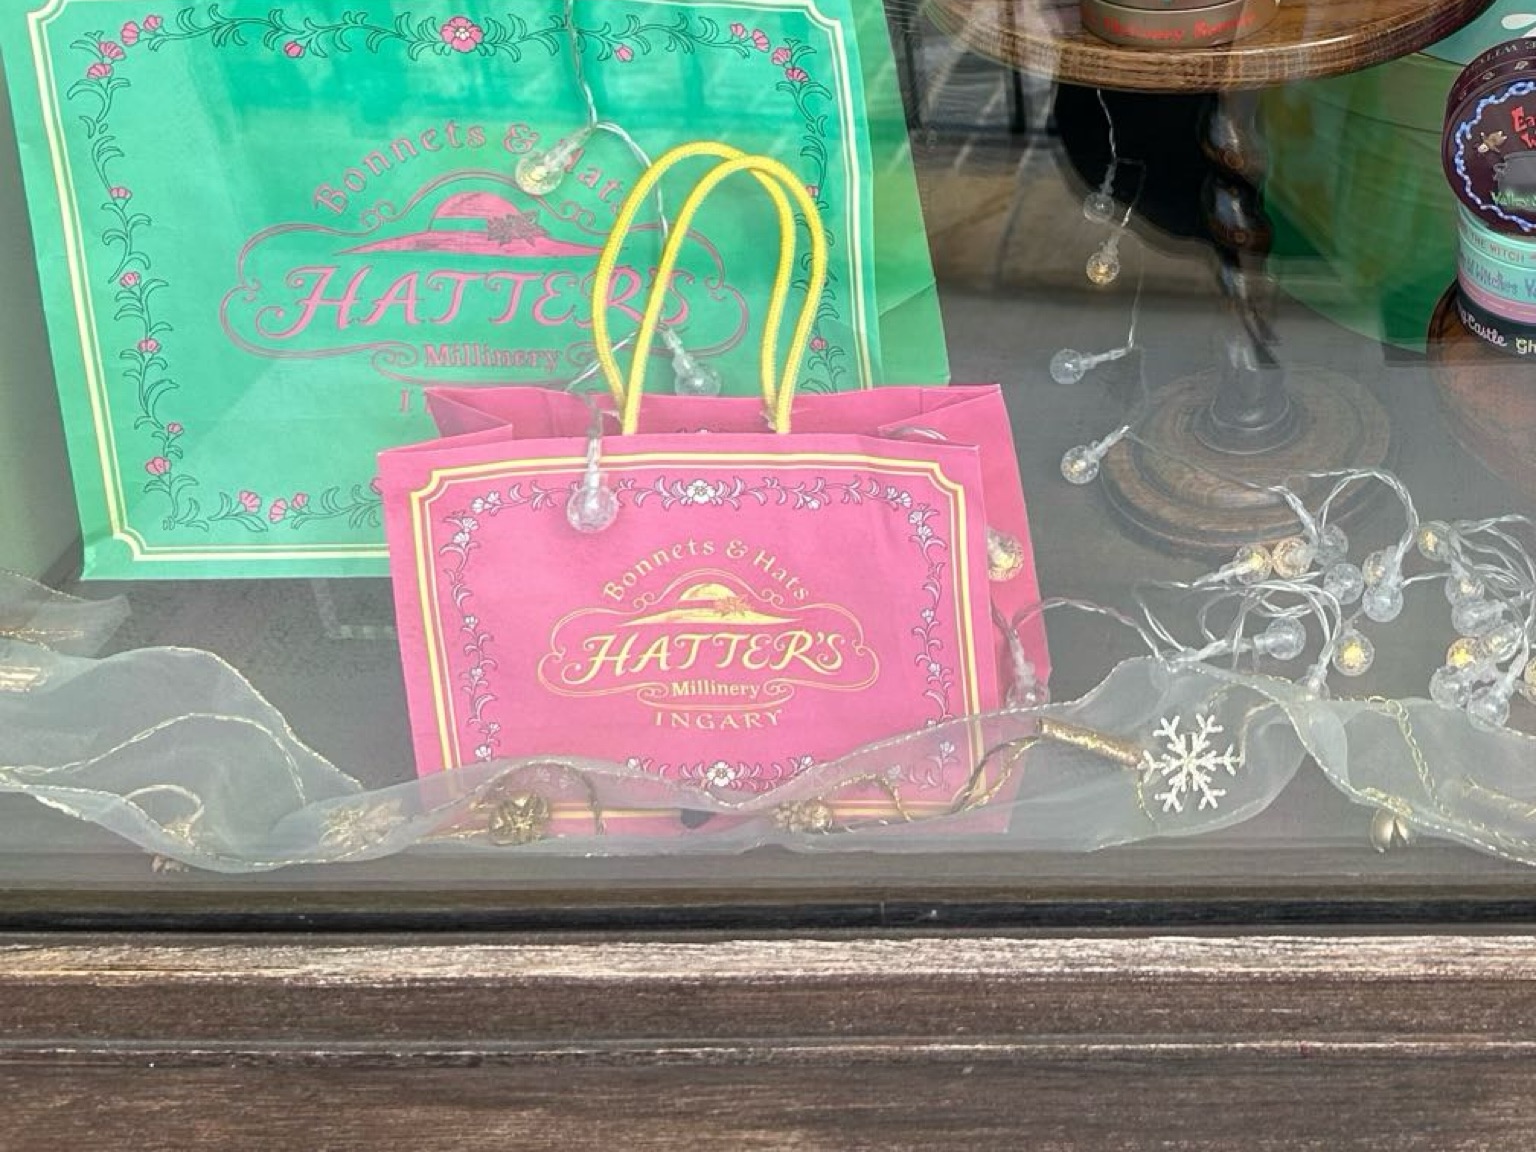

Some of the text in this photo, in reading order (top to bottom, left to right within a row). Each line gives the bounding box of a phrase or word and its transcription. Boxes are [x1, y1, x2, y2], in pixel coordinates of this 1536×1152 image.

[312, 118, 487, 216] Bonnets
[502, 123, 541, 154] &
[1467, 312, 1508, 347] Castle
[424, 345, 560, 373] Millinery
[602, 537, 810, 602] Bonnets & Hats
[560, 629, 846, 686] HATTER'S
[671, 679, 762, 699] Millinery
[654, 708, 783, 732] INGARY
